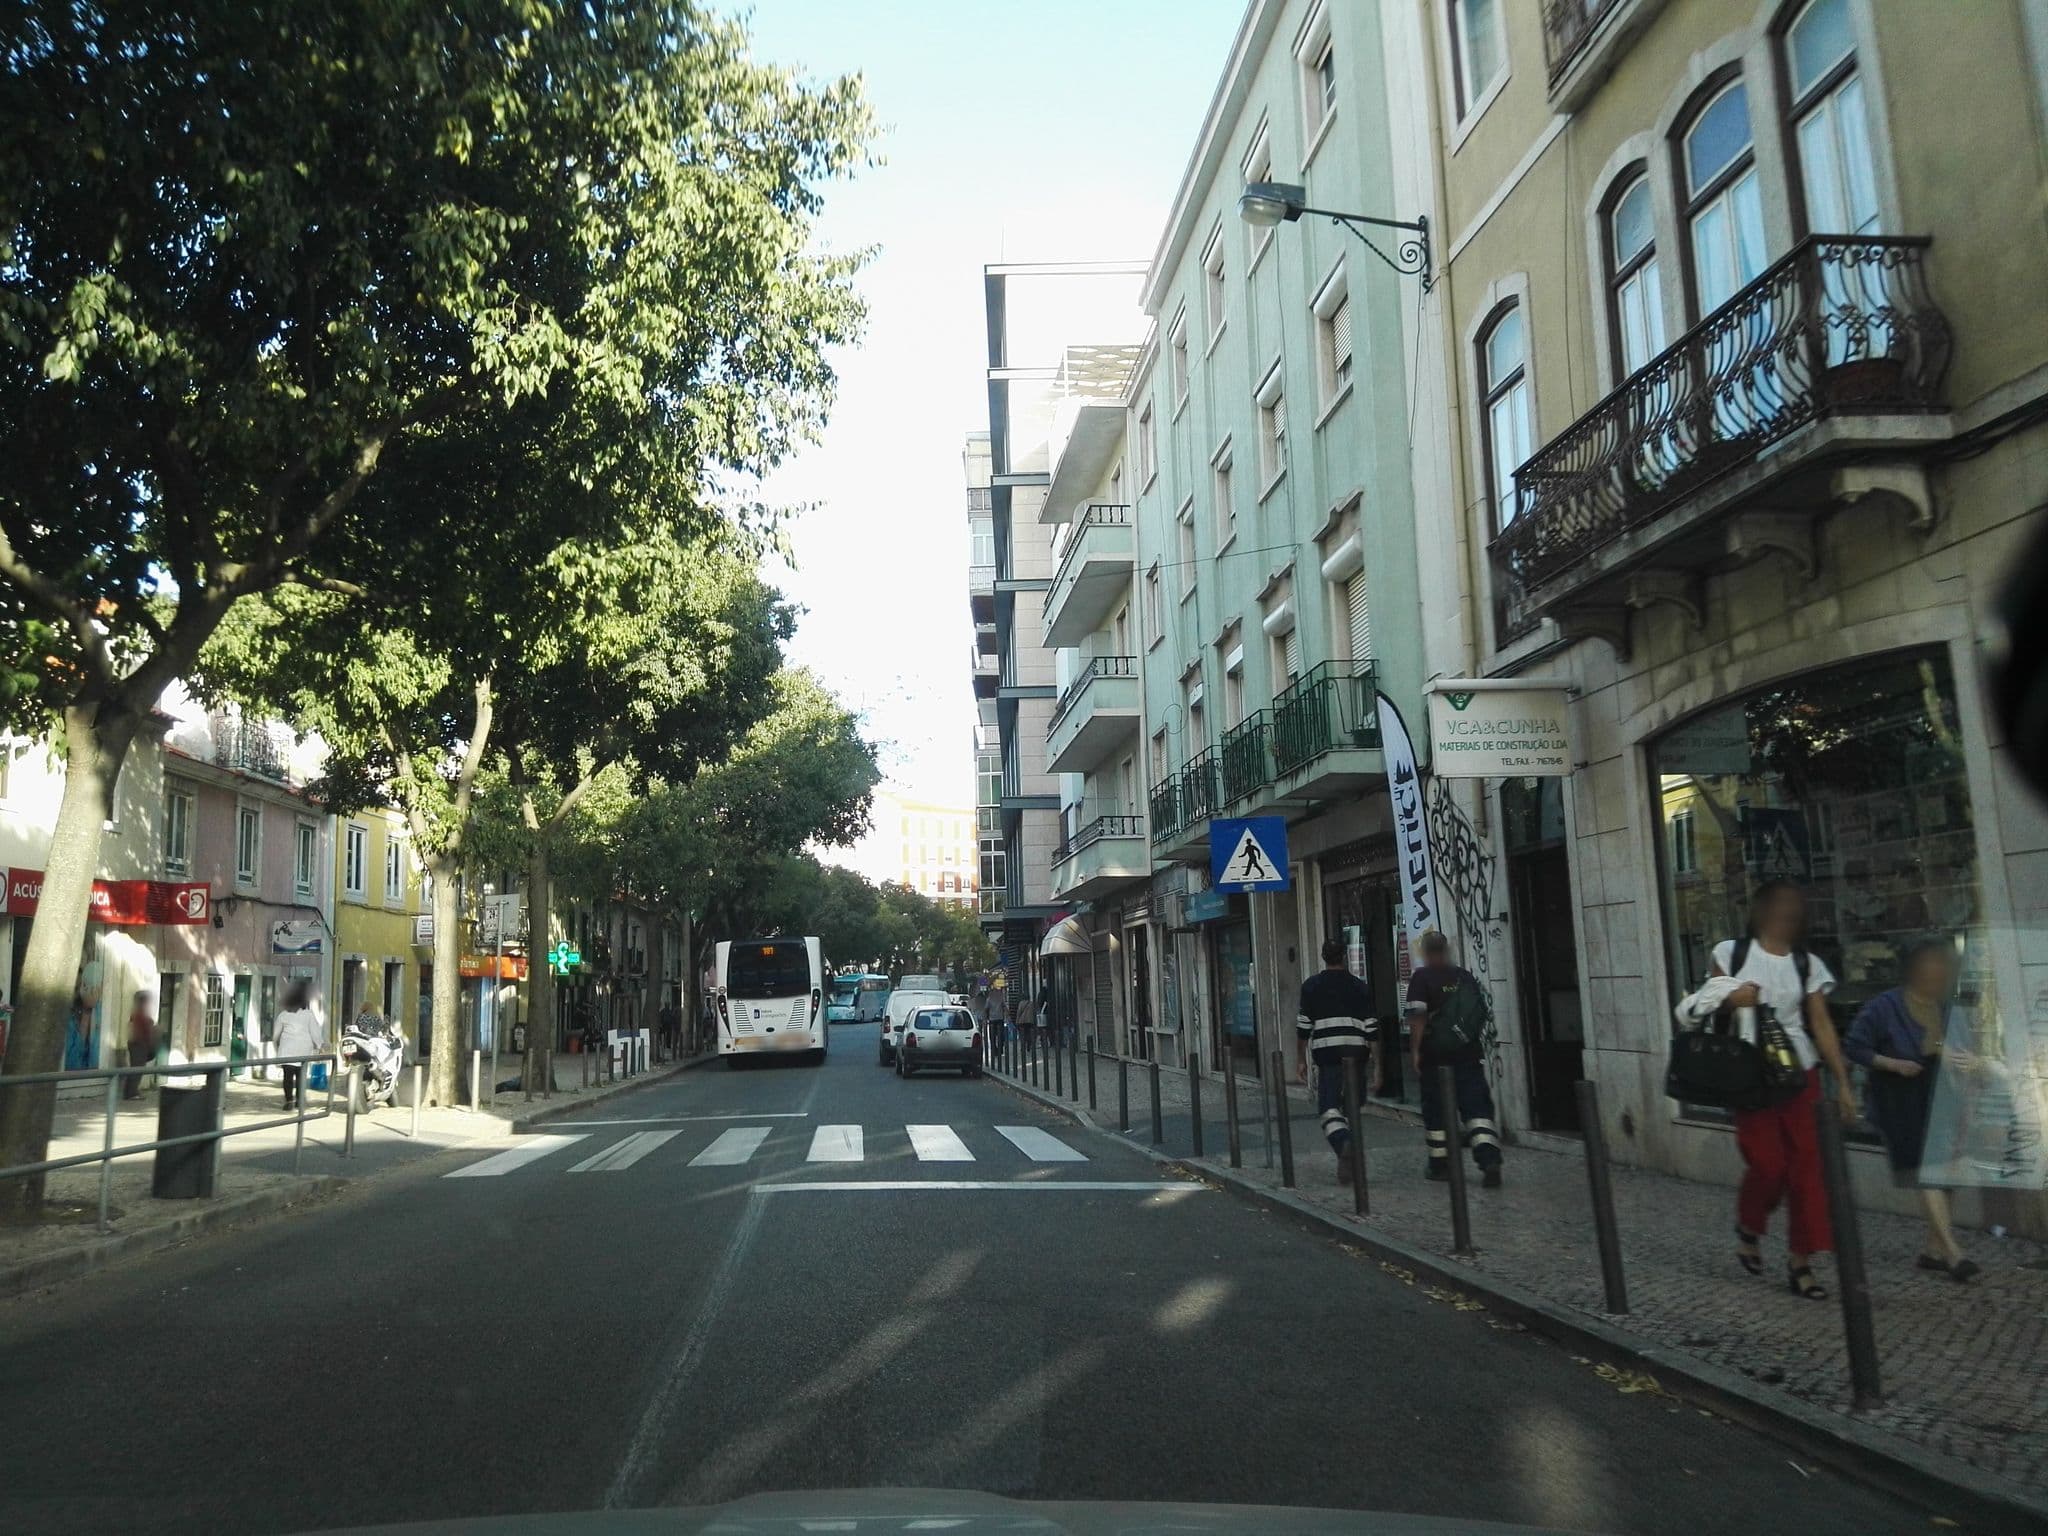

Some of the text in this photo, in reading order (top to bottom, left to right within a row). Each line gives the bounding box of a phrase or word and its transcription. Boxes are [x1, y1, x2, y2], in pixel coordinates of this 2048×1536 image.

[1440, 738, 1568, 752] MATERIAIS DE CONSTRUÇÃO LDA
[13, 881, 110, 906] ACÚS DICA
